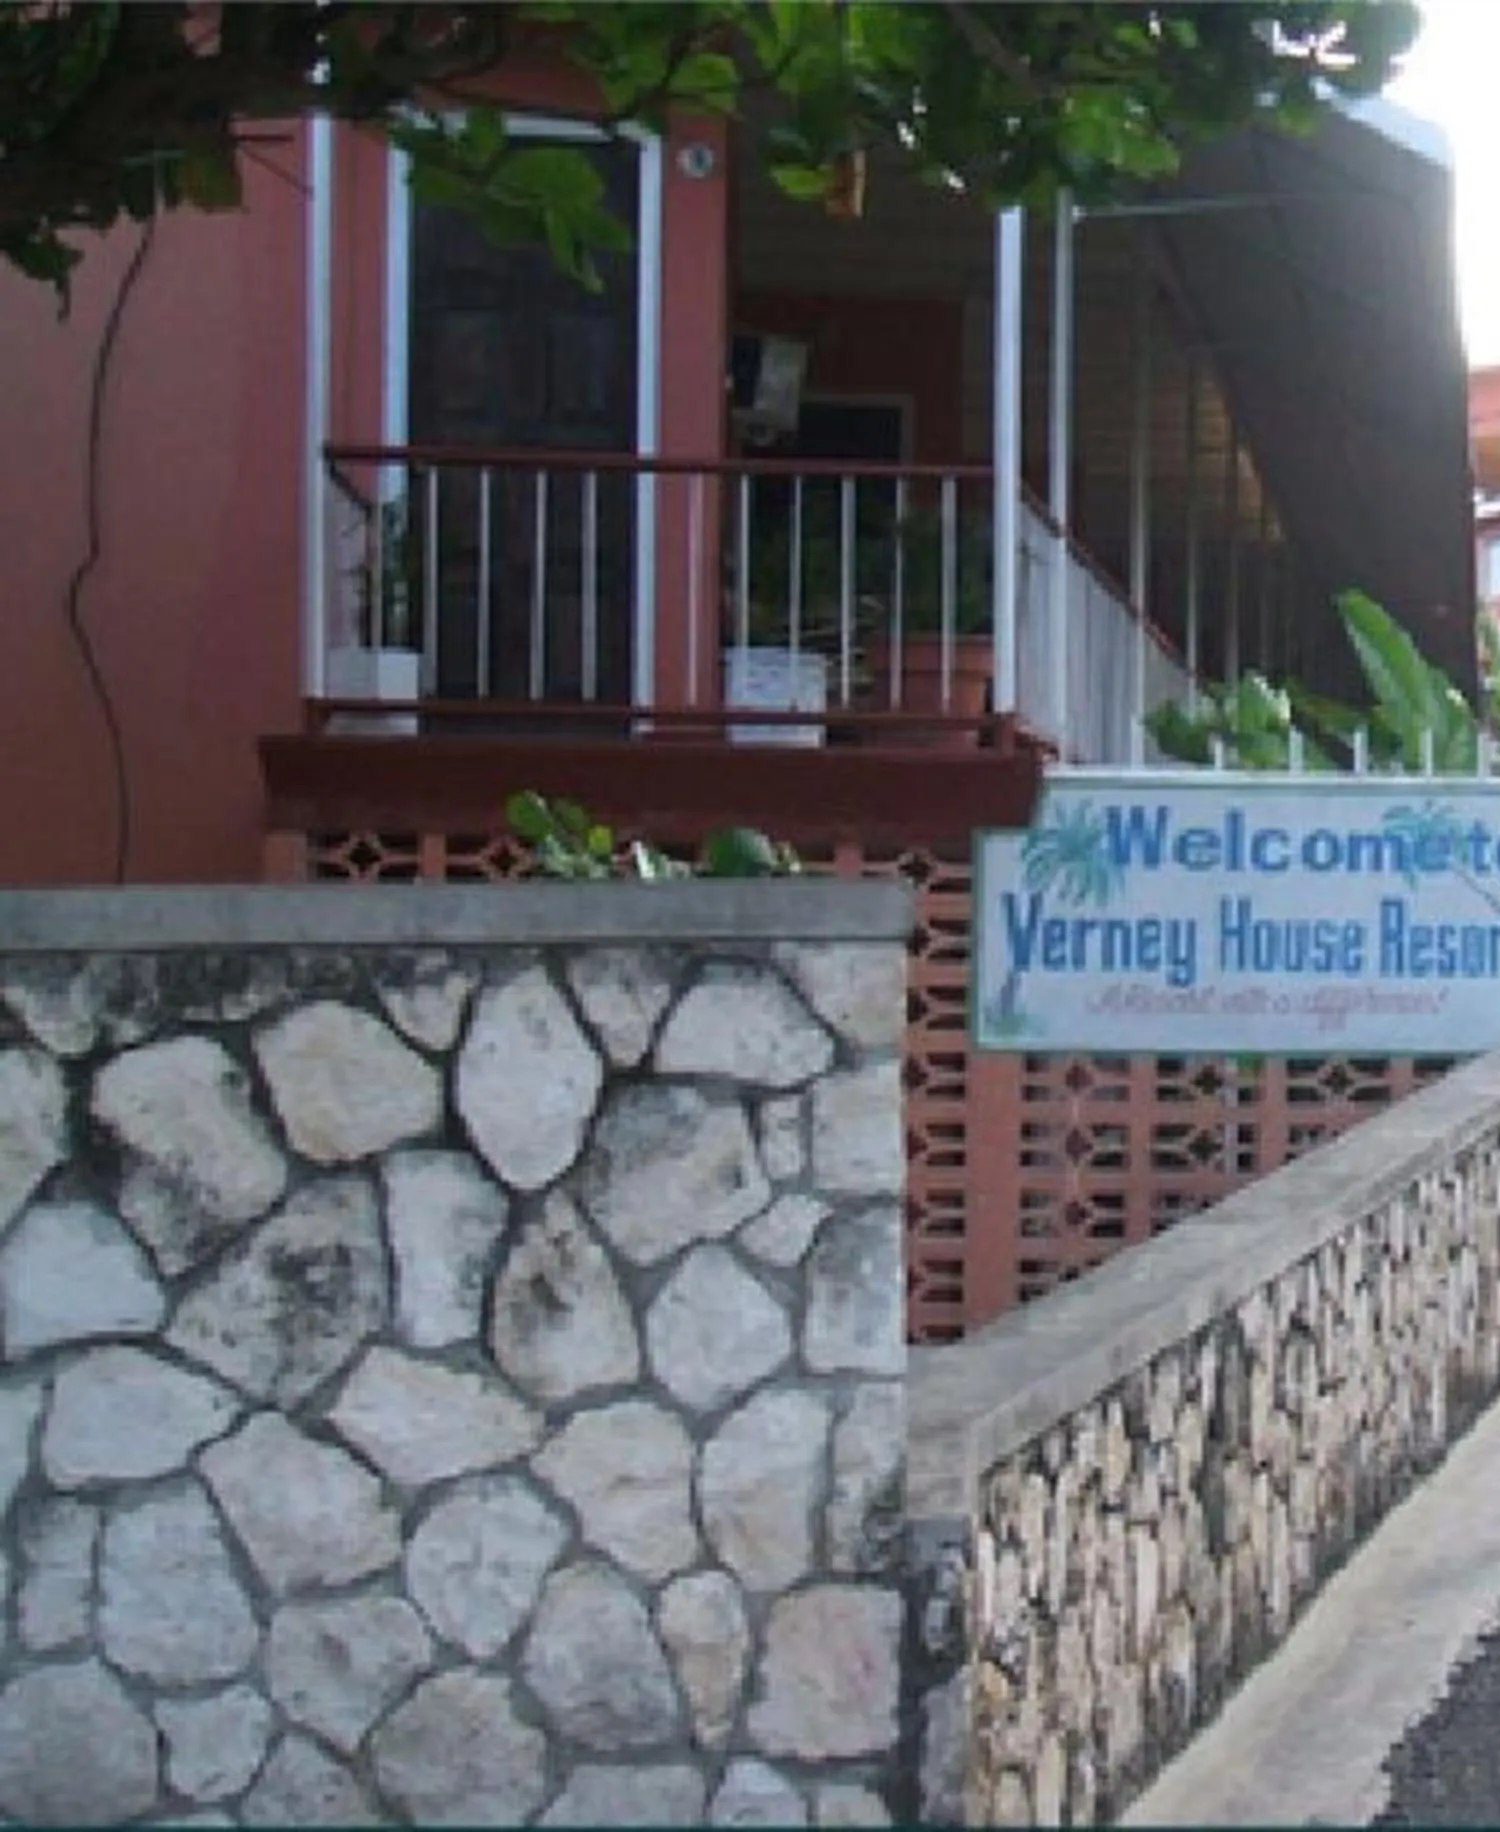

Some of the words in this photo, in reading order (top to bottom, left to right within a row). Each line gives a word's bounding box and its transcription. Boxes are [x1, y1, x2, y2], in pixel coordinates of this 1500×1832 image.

[1105, 803, 1453, 874] Welcome
[1002, 892, 1198, 986] Verney
[1218, 896, 1366, 975] House
